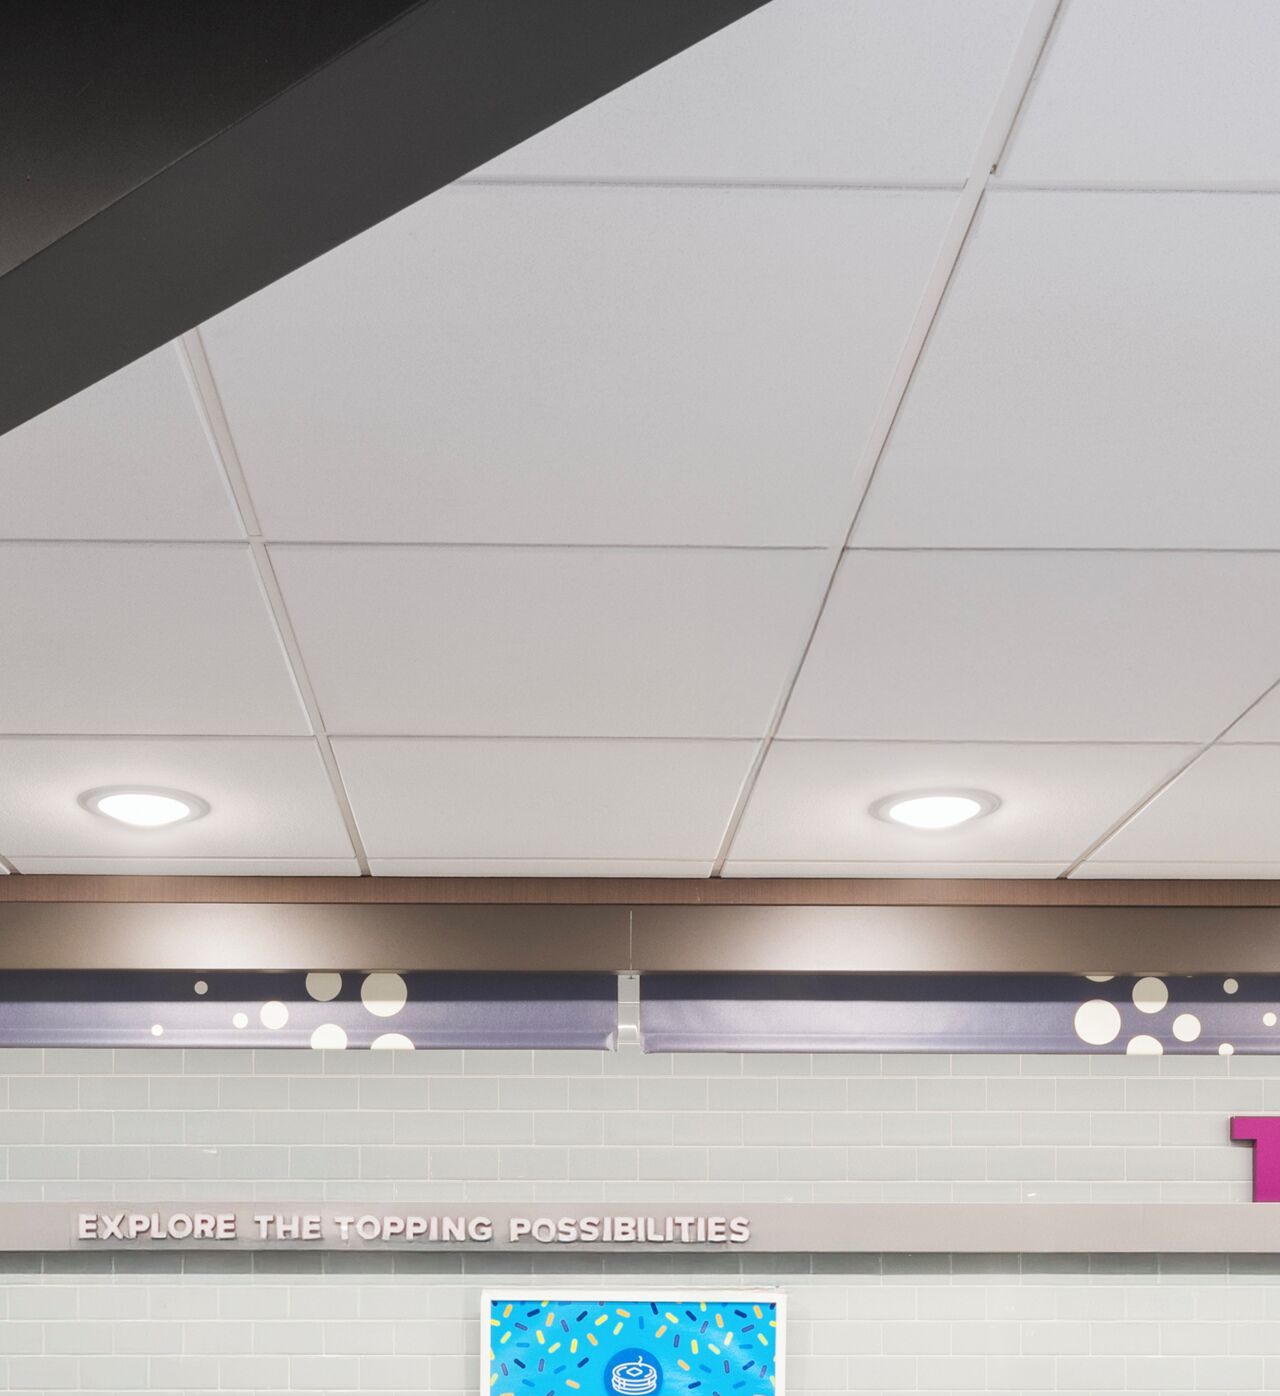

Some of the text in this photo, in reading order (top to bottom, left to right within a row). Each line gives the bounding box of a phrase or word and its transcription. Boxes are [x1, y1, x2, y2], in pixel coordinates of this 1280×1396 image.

[78, 1214, 751, 1243] EXPLORE THE TOPPING POSSIBILITIES
